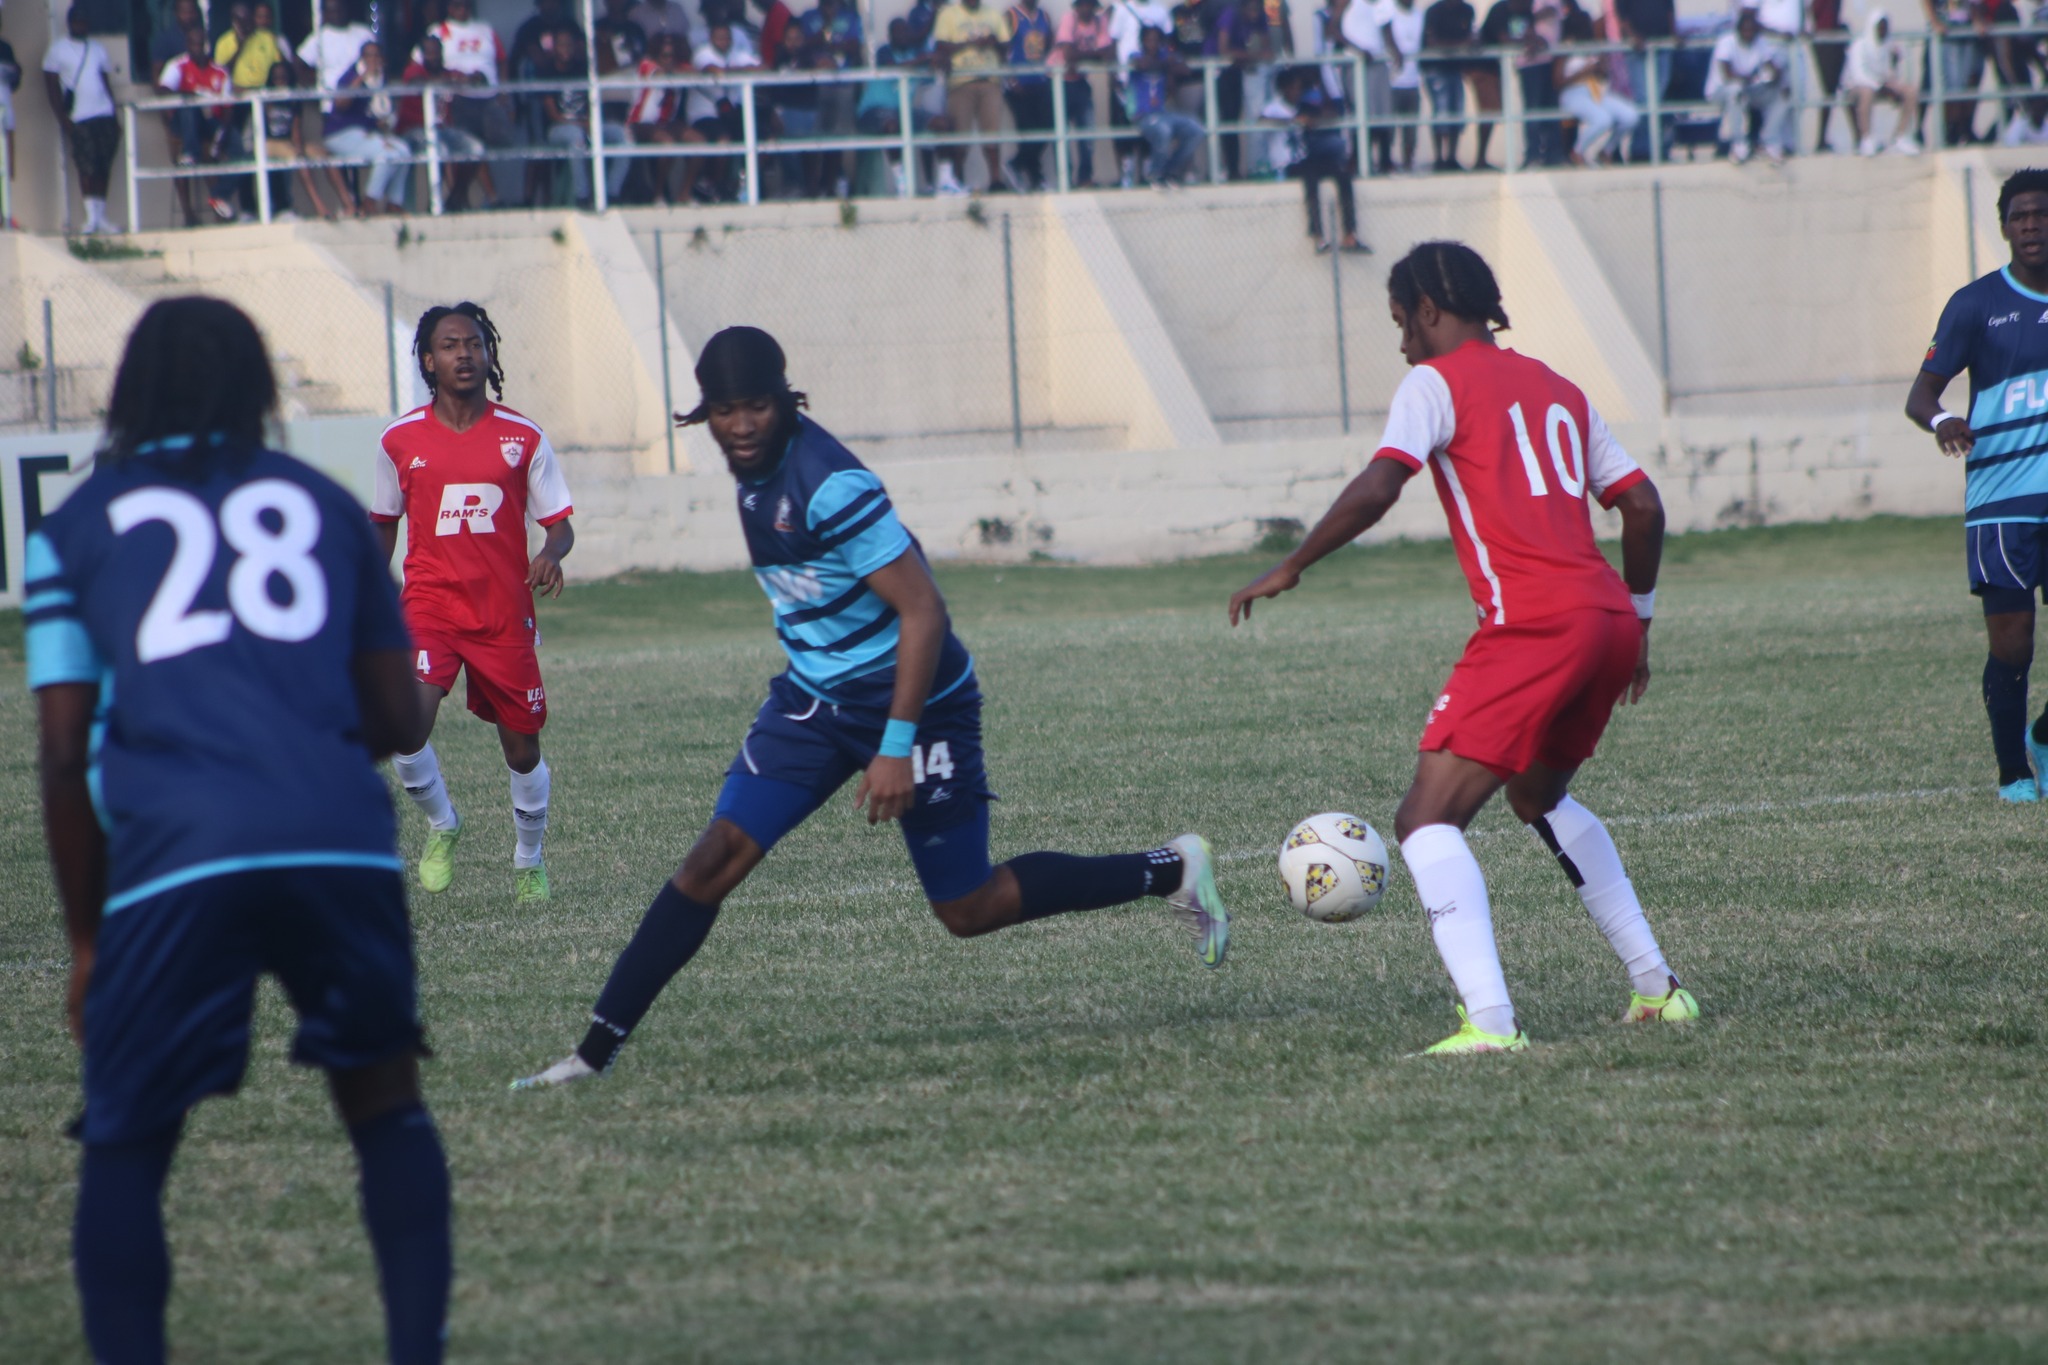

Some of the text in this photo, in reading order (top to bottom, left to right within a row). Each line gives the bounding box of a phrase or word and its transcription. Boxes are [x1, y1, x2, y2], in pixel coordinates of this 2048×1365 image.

[2009, 311, 2020, 322] FC
[2005, 375, 2048, 415] FL
[1507, 401, 1586, 499] 10
[435, 482, 504, 537] R
[440, 508, 489, 520] RAM'S
[107, 478, 328, 664] 28
[416, 649, 431, 675] 4
[912, 740, 955, 784] 14
